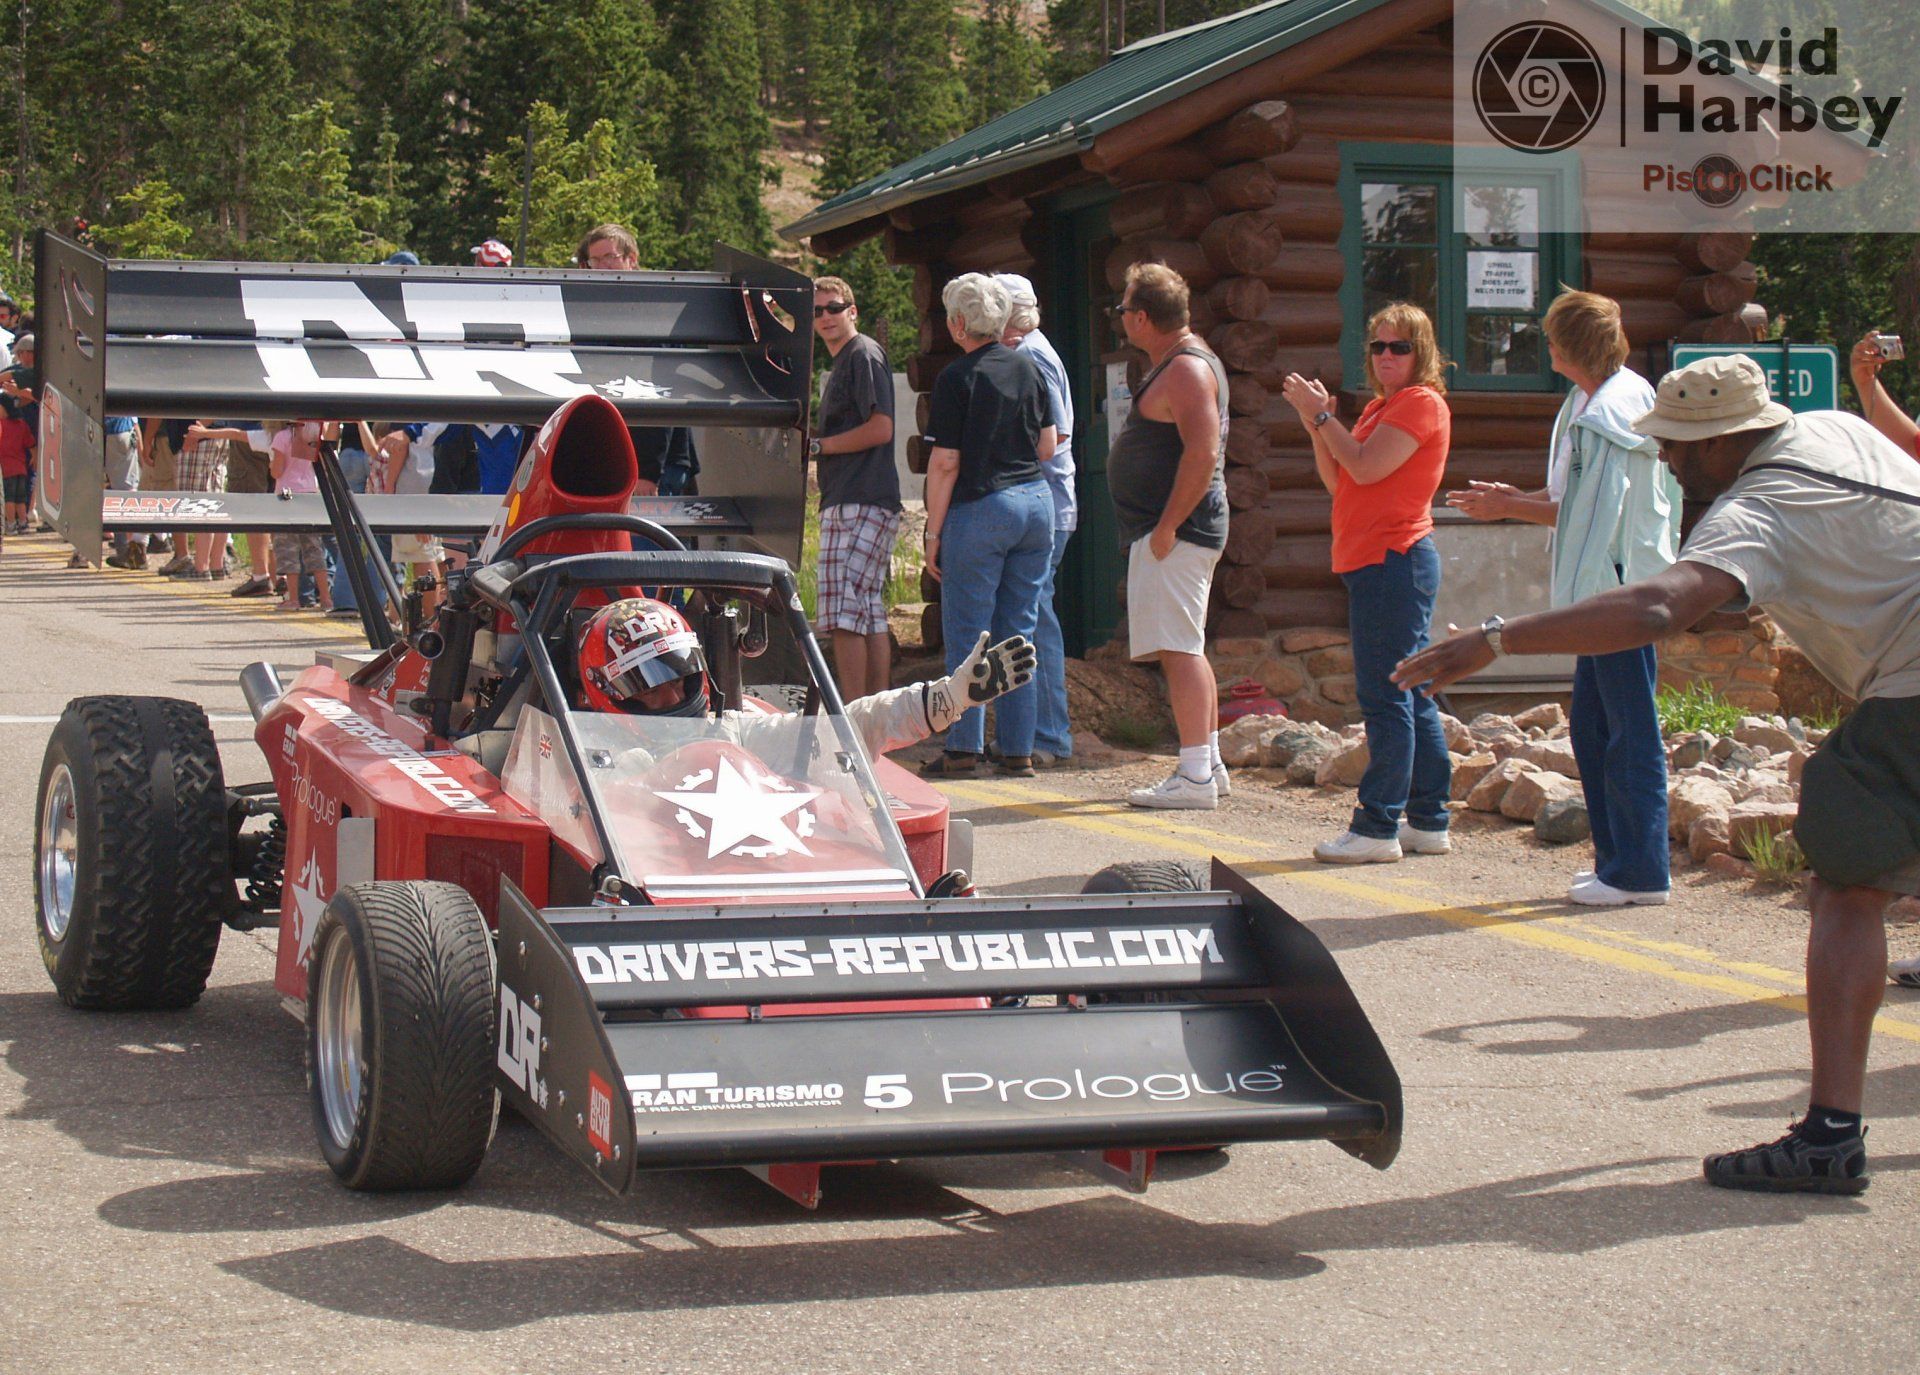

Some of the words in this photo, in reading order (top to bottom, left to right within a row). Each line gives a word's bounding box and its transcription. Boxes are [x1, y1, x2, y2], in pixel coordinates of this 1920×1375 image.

[1766, 369, 1813, 397] EED
[102, 496, 181, 513] EARY
[573, 928, 1225, 984] DRIVERS-REPUBLIC.COM
[632, 1089, 697, 1107] RAN
[705, 1083, 844, 1103] TURISMO
[863, 1074, 914, 1109] 5
[691, 1102, 754, 1112] DRIVING
[755, 1099, 843, 1109] SIMULATOR
